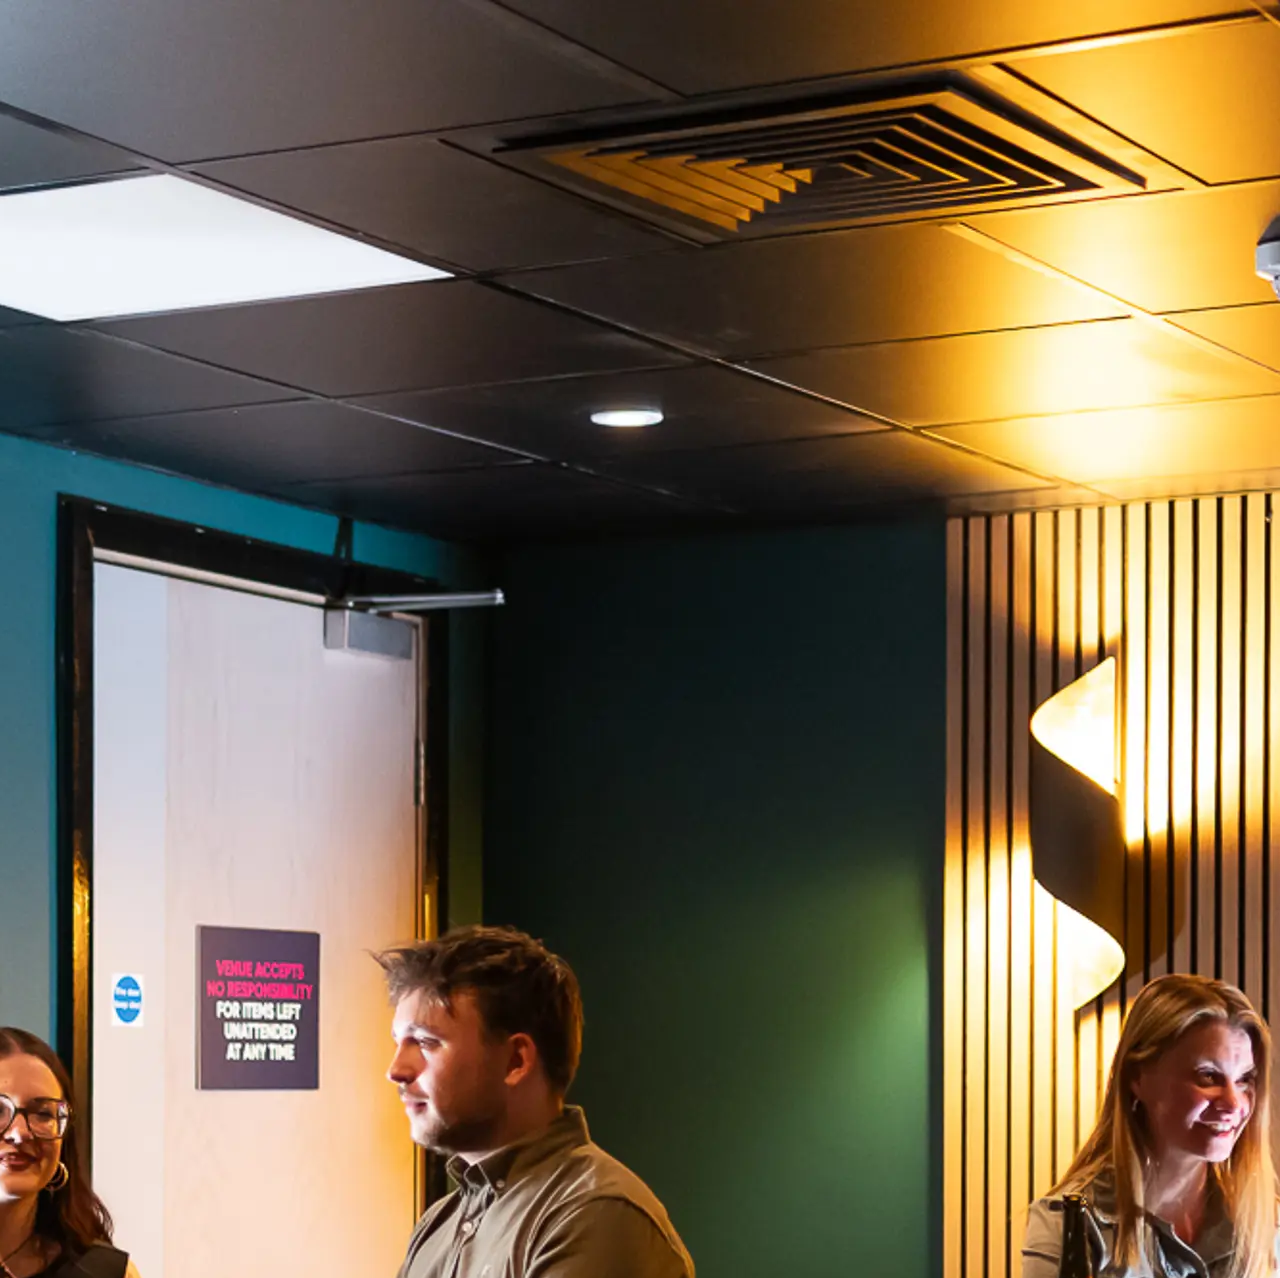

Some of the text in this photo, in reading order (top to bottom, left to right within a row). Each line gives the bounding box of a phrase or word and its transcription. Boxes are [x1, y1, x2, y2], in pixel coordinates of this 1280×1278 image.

[216, 960, 304, 980] VENUE ACCEPTS
[207, 980, 312, 999] NO RESPONSIBILITY
[216, 1001, 301, 1020] FOR ITEMS LEFT
[224, 1022, 297, 1040] UNATTENDED
[226, 1043, 295, 1060] AT ANY TIME
